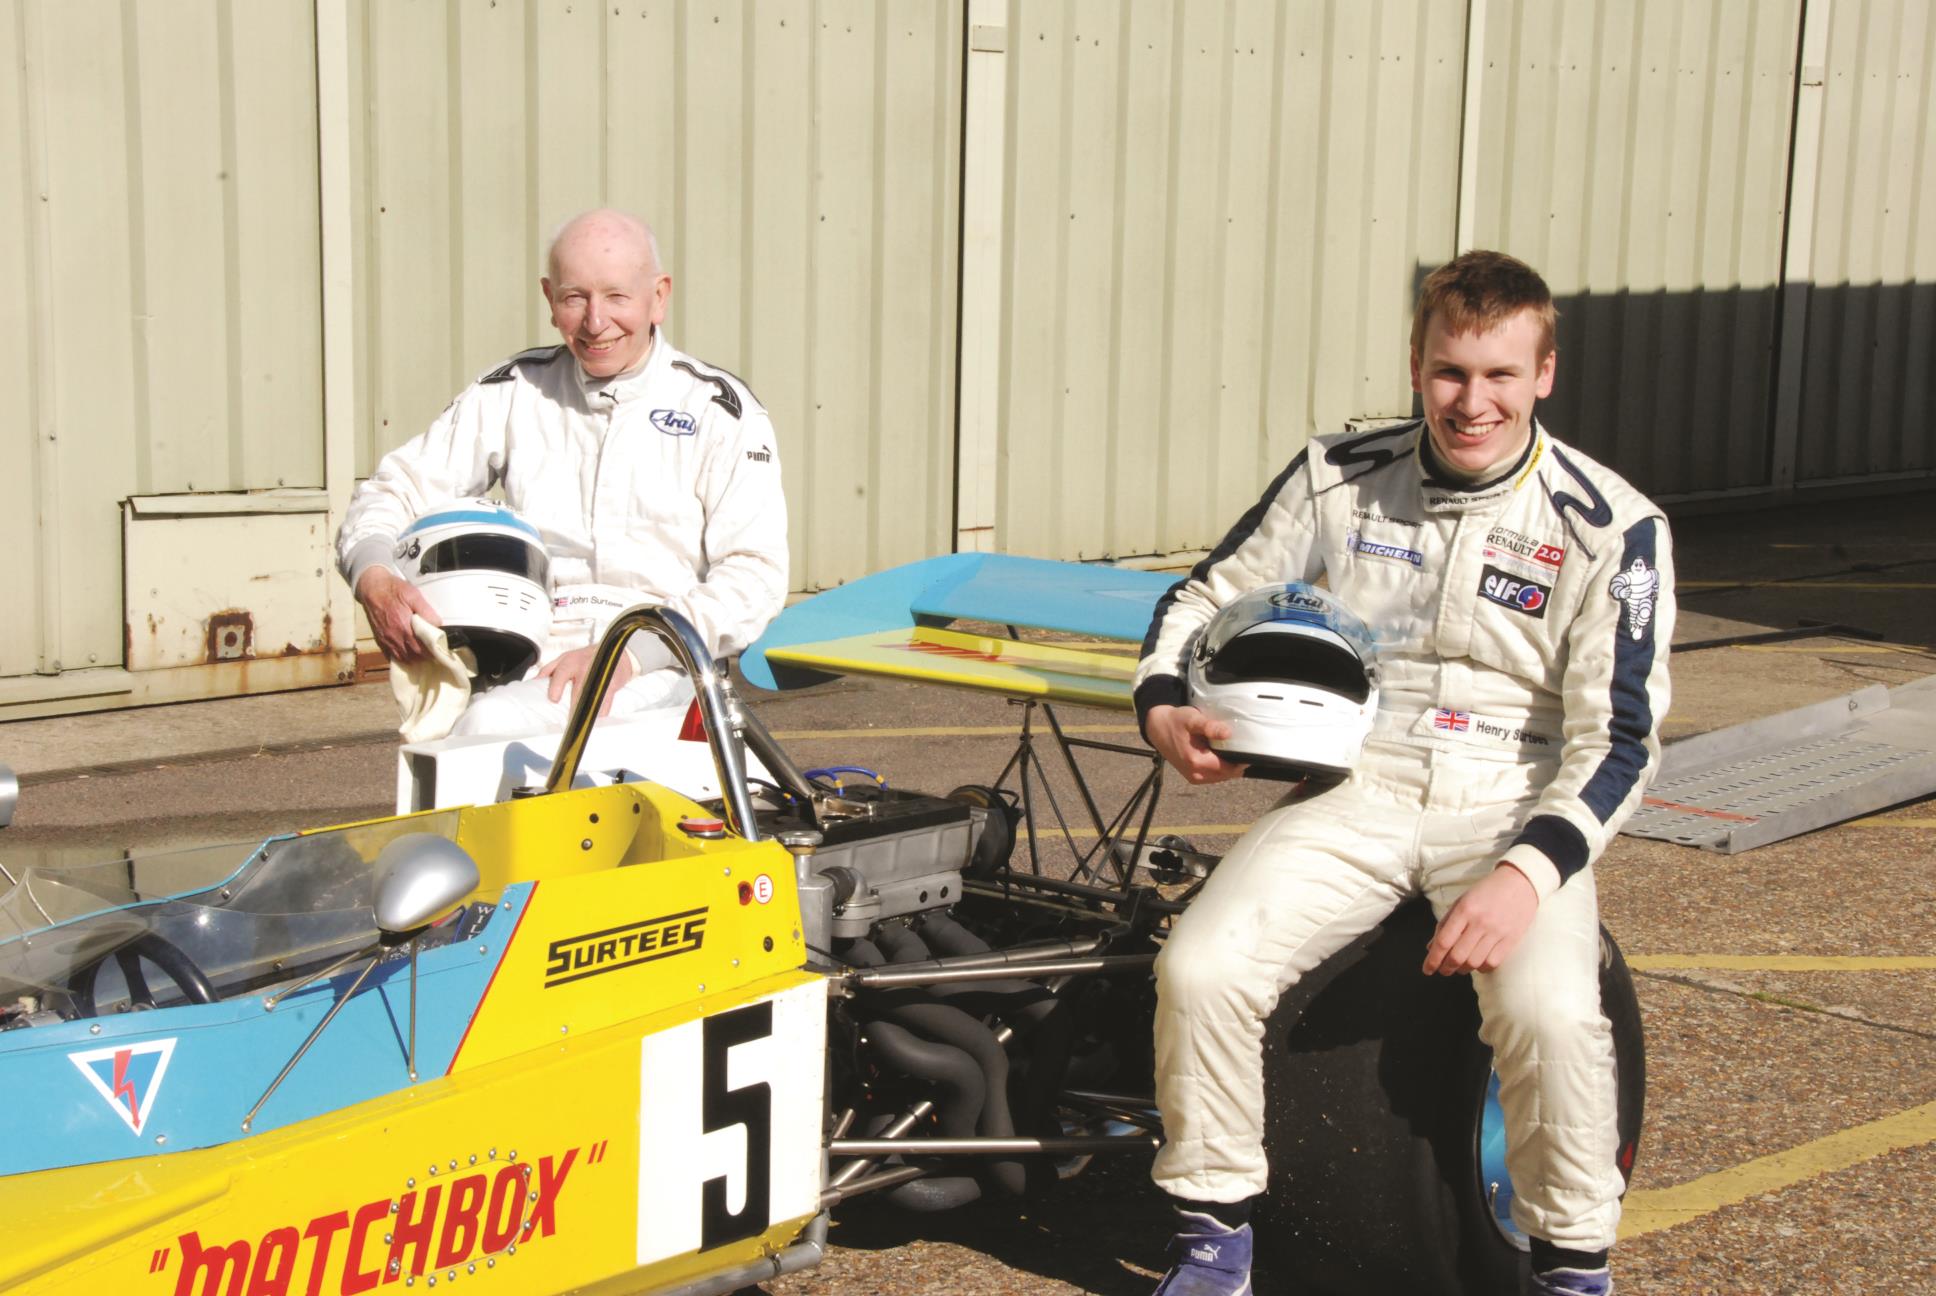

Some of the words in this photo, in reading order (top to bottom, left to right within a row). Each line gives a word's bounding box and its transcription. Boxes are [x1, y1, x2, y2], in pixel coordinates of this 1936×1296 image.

[655, 410, 693, 432] Arai
[1429, 496, 1468, 505] RENAULT
[1352, 509, 1386, 523] RENAULT
[1359, 542, 1421, 564] MICHELIN
[1486, 534, 1535, 557] RENAULT
[570, 596, 589, 605] John
[1476, 720, 1510, 741] Henry
[759, 881, 768, 898] E
[545, 910, 708, 984] SURTEES
[701, 1000, 773, 1253] 5
